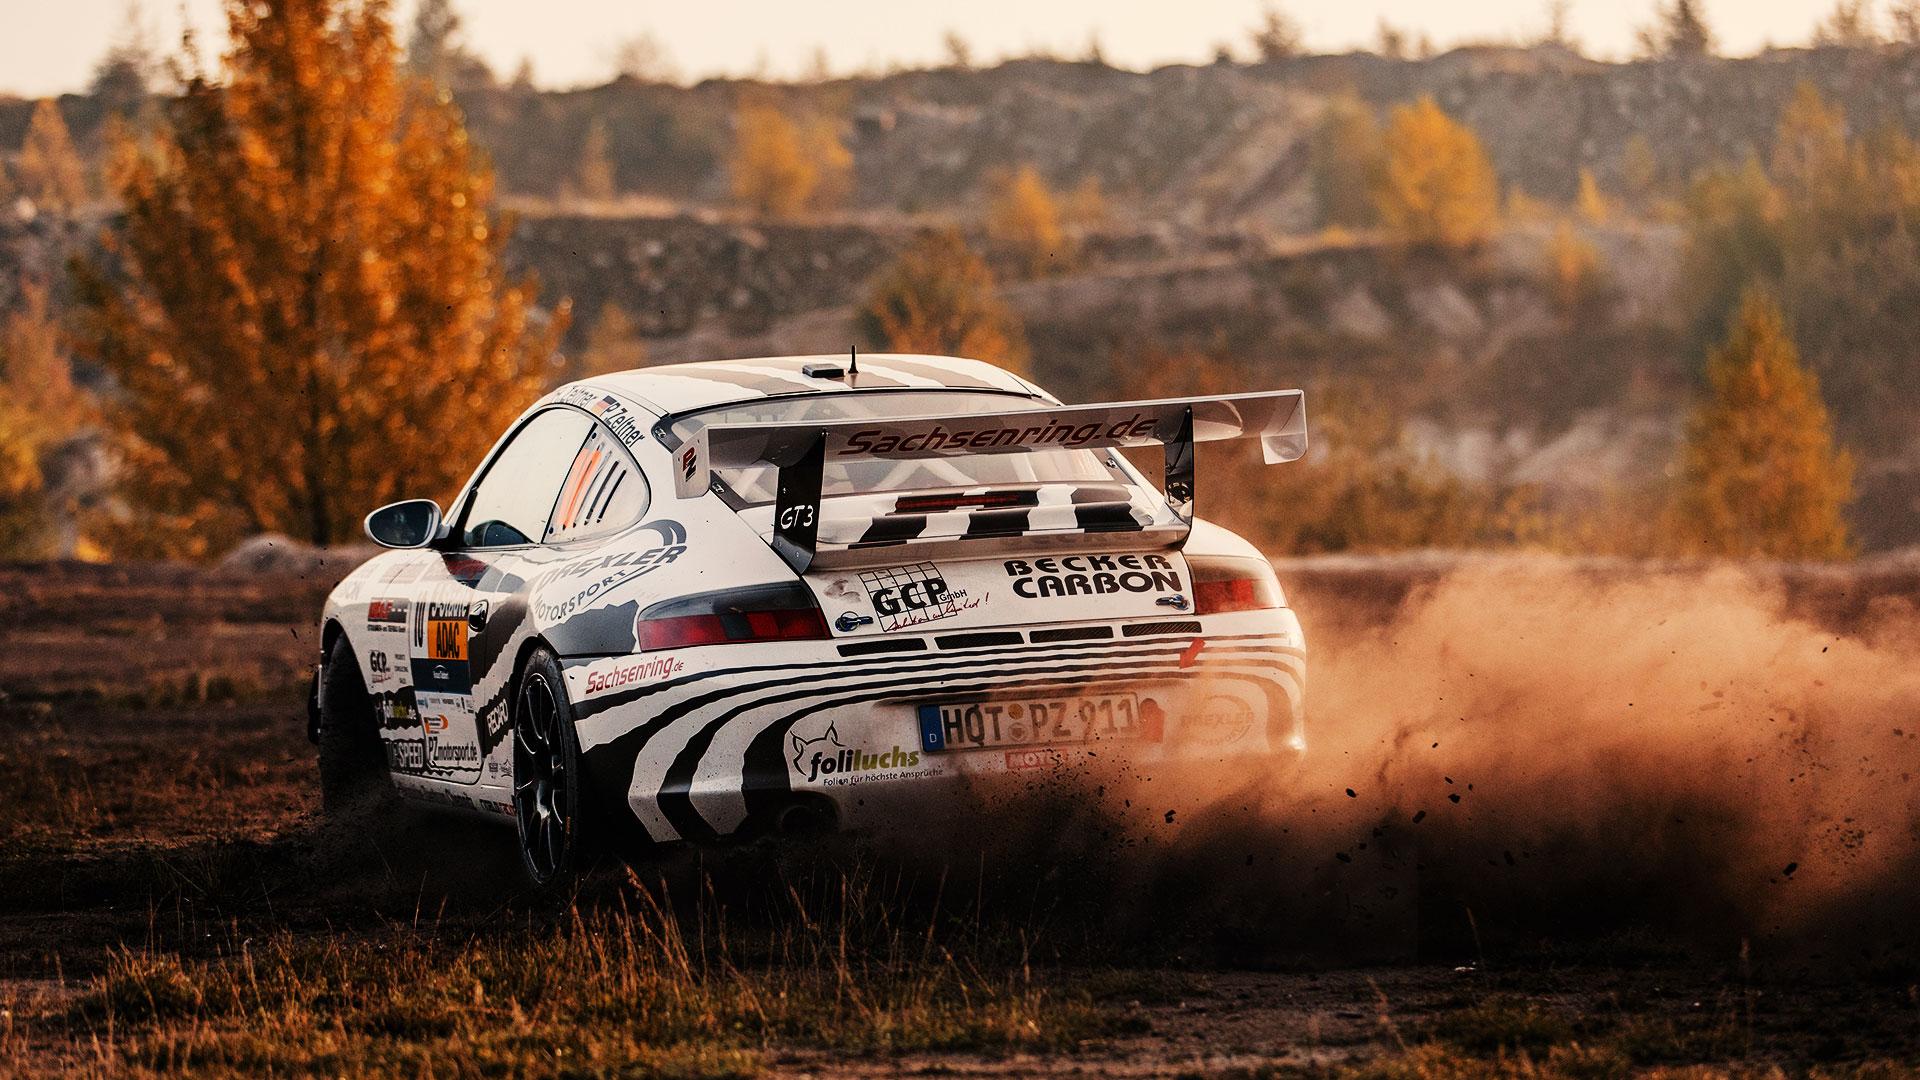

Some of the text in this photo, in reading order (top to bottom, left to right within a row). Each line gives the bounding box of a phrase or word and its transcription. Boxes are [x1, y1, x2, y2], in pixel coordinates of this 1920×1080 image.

[838, 413, 1159, 456] Sachsenring.de
[536, 545, 688, 594] DREXLER
[1003, 554, 1173, 577] BECKER
[1012, 571, 1183, 599] CARBON
[534, 569, 626, 622] MOTORSPORT
[872, 577, 968, 616] GCP GmbH
[436, 621, 460, 659] ADAC
[585, 655, 684, 695] Sachsenring.de
[486, 698, 509, 737] RECARO
[929, 732, 938, 744] D
[1028, 701, 1072, 739] PZ
[1078, 698, 1138, 744] 911
[807, 745, 920, 783] foliluchs
[823, 768, 945, 787] Folien für höchste Ansprüche
[1009, 751, 1079, 773] MOT
